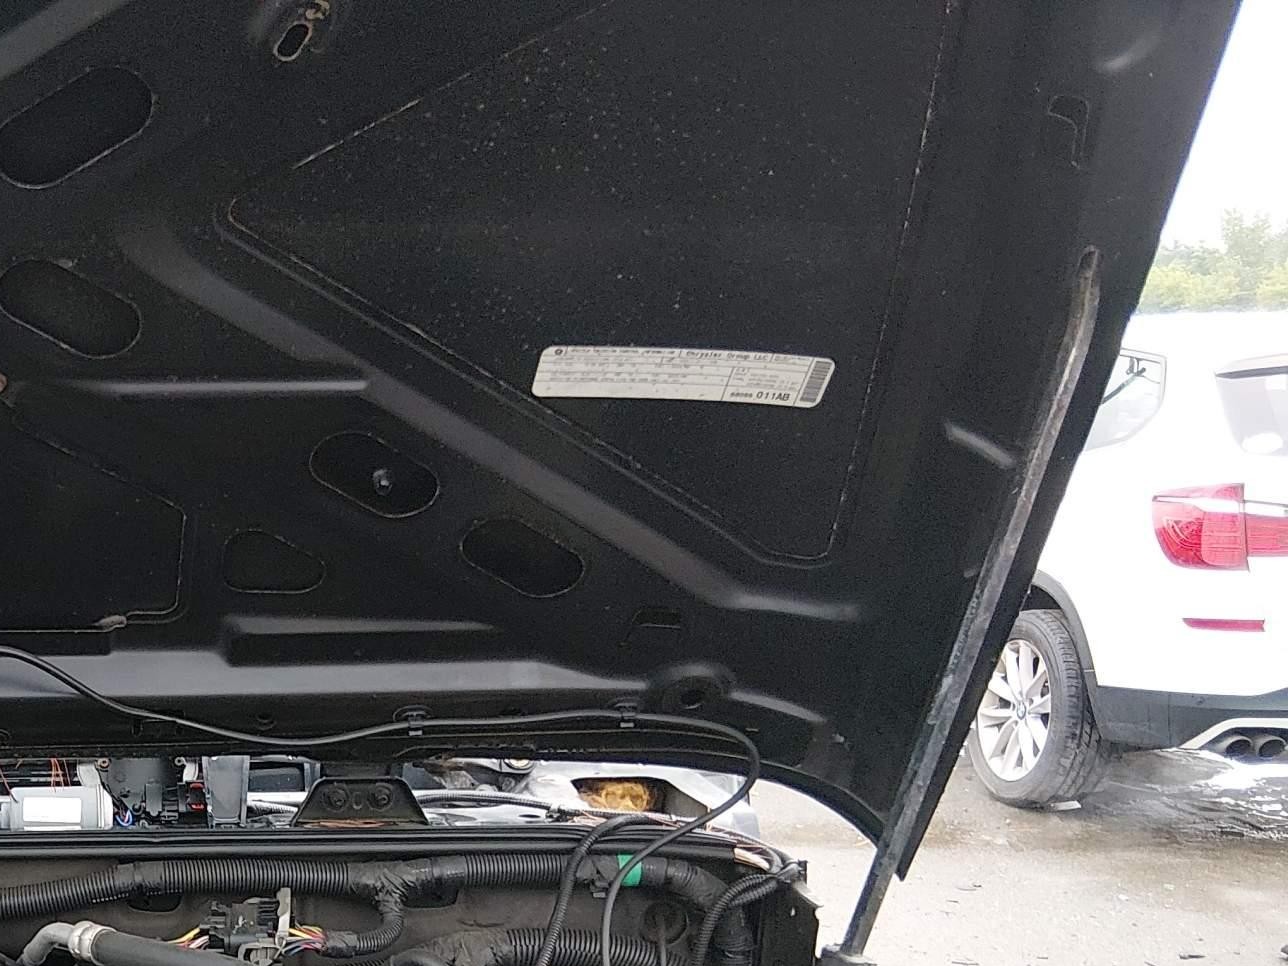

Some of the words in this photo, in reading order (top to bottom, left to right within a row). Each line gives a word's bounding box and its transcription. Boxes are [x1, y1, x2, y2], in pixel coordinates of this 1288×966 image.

[686, 350, 722, 360] Chrysler
[727, 352, 750, 361] Group
[754, 353, 769, 361] LLC
[756, 391, 791, 402] 011AB
